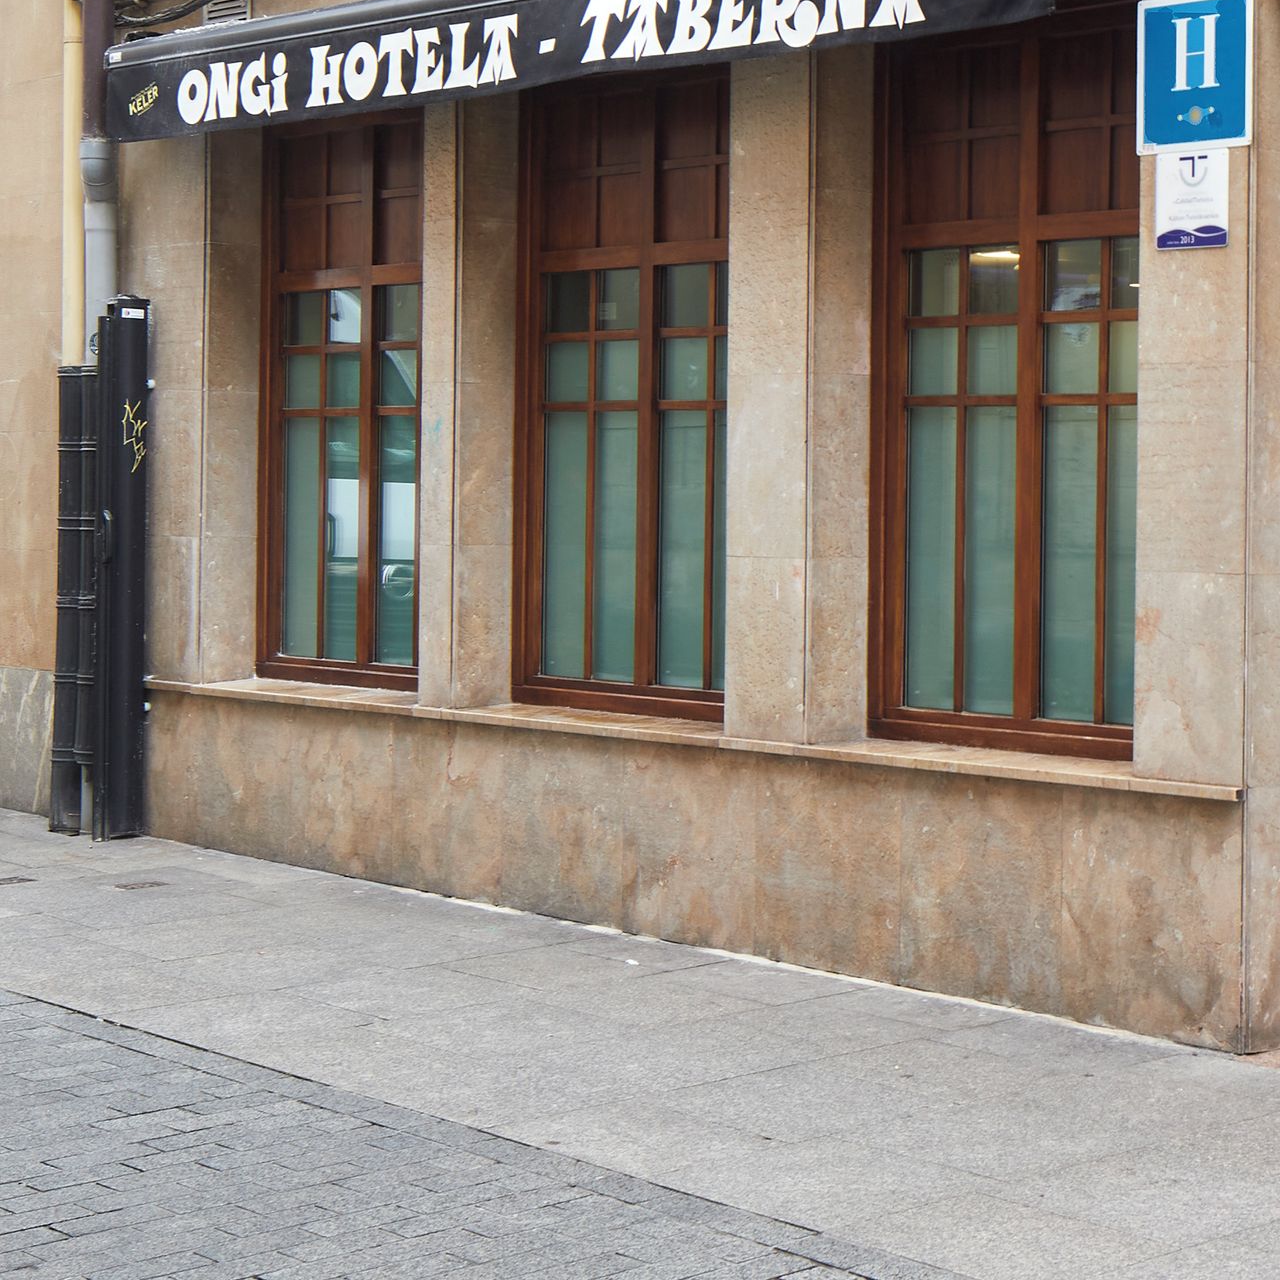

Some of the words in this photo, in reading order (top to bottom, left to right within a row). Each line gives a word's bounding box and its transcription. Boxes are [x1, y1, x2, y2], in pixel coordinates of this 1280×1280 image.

[305, 13, 518, 108] HOTELA
[1170, 13, 1221, 92] H
[128, 85, 159, 116] KELER
[1180, 235, 1195, 245] 2013
